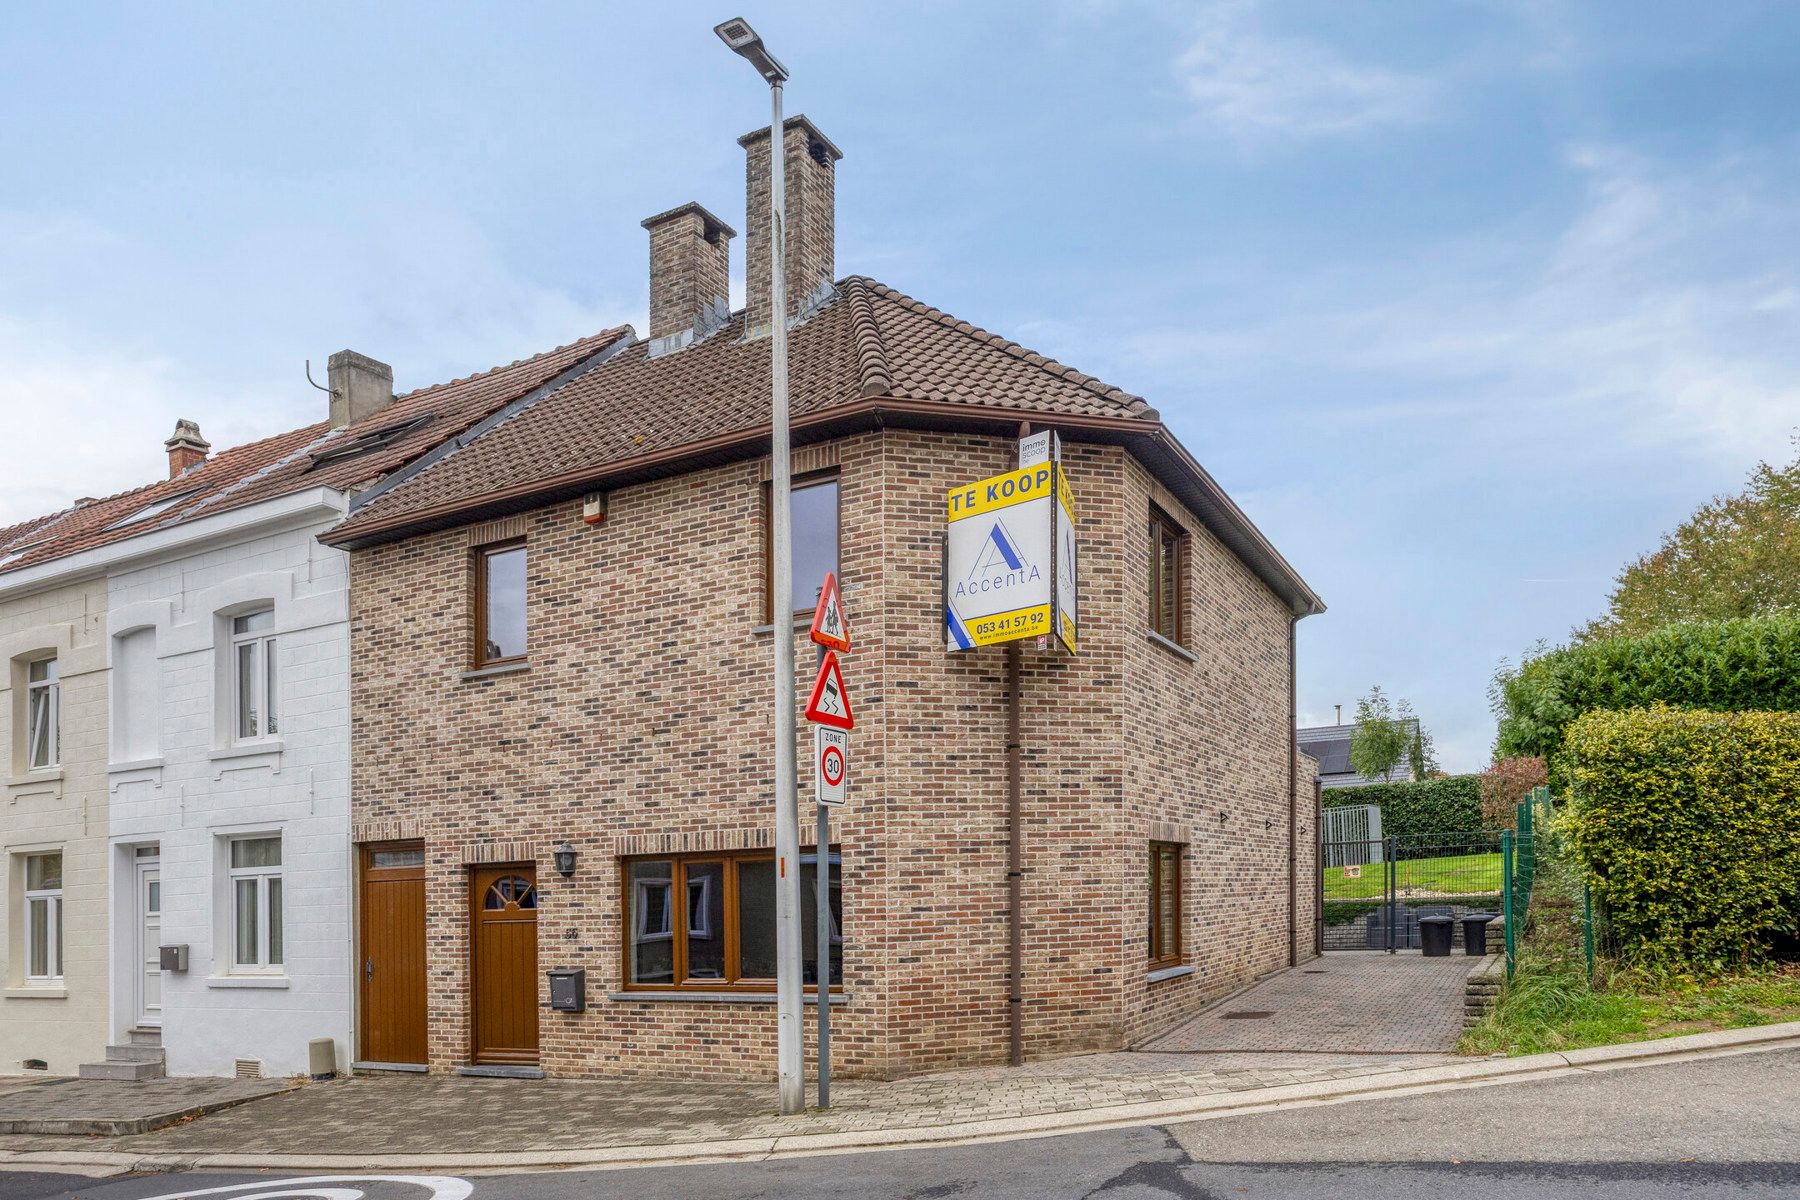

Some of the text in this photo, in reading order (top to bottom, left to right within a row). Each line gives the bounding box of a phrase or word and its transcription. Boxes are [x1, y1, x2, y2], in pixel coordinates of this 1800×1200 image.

[1022, 439, 1046, 451] immo
[1022, 447, 1046, 459] scoop
[951, 489, 976, 512] TE
[986, 469, 1049, 503] KOOP
[955, 564, 1041, 598] AccentA
[976, 612, 1044, 635] 053 41 57 92
[825, 732, 842, 744] ZONE
[827, 758, 840, 774] 30
